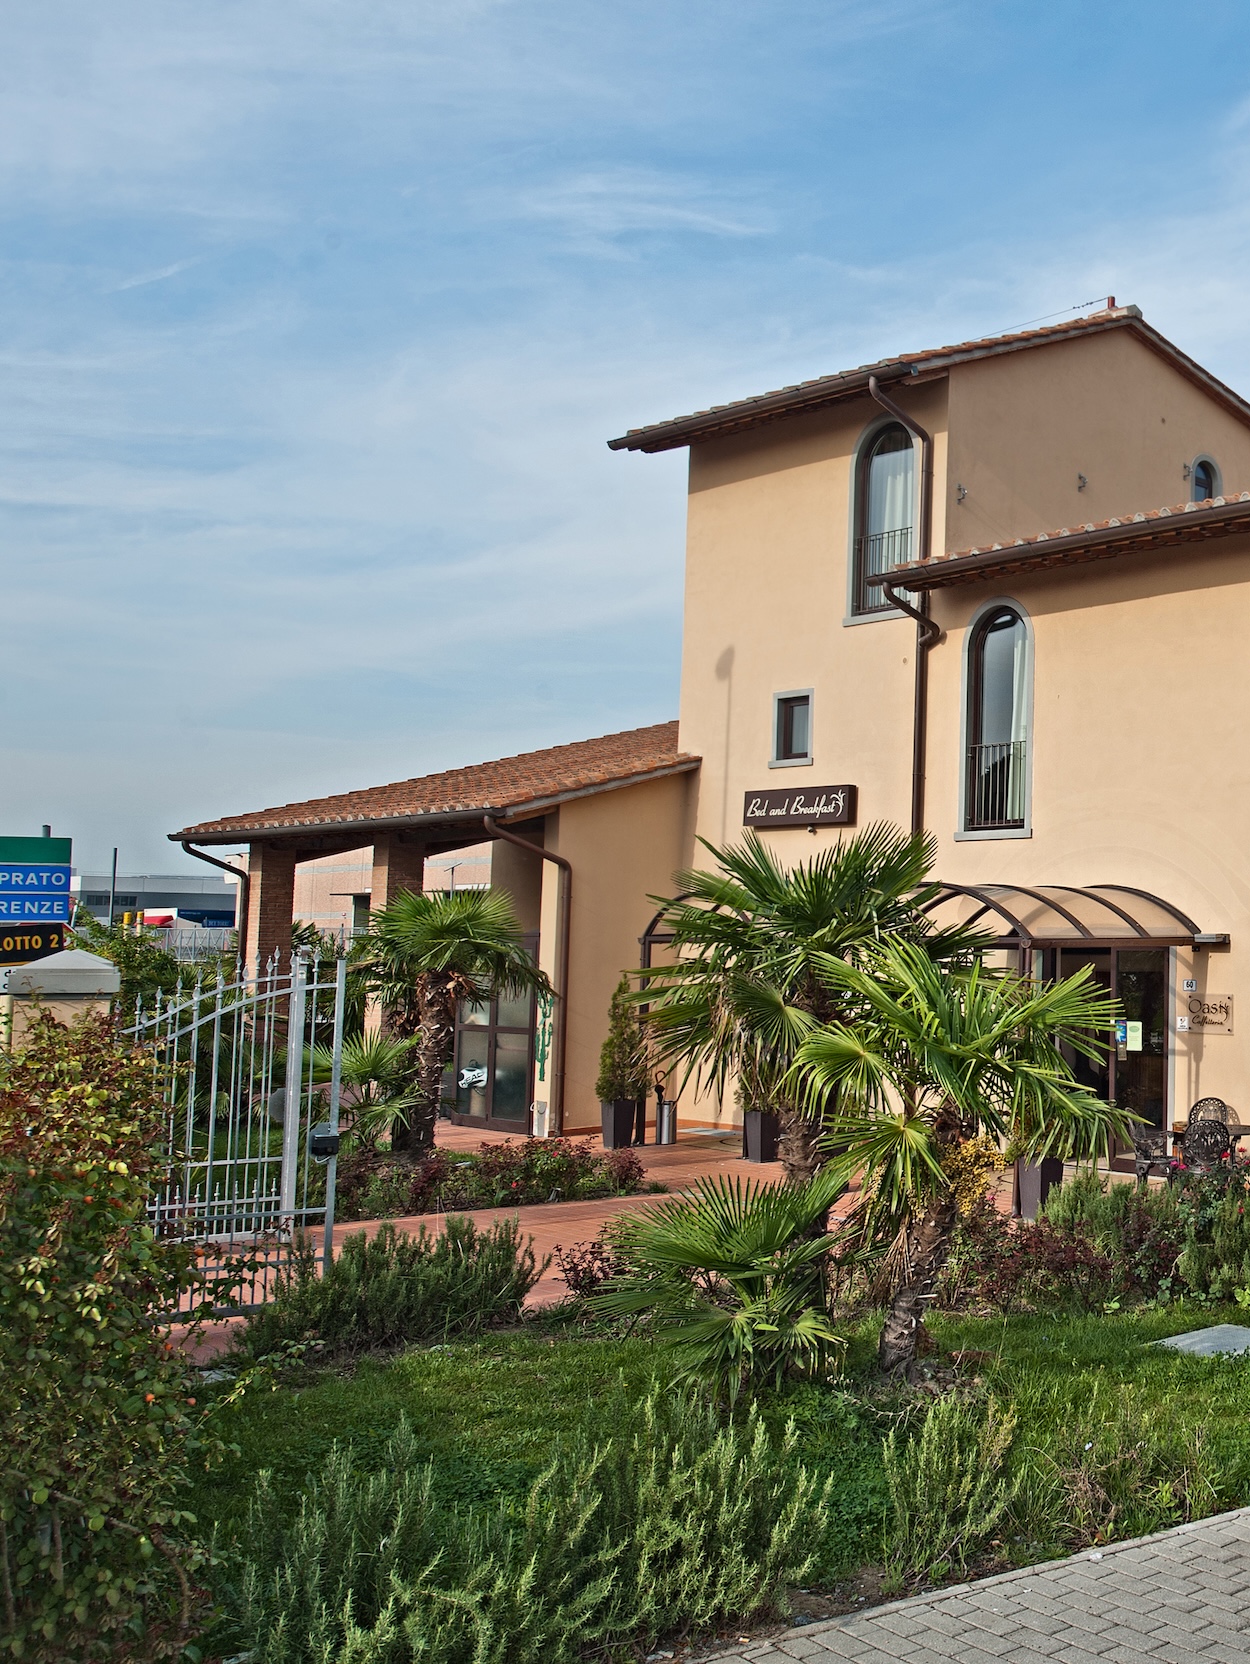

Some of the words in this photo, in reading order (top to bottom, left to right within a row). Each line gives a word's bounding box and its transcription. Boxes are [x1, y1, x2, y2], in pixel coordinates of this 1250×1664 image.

[746, 798, 769, 817] Bed
[769, 798, 790, 816] and
[790, 794, 836, 818] Breakfast
[0, 872, 66, 886] PRATO
[49, 933, 59, 948] 2
[1191, 1014, 1224, 1027] Caffetteria
